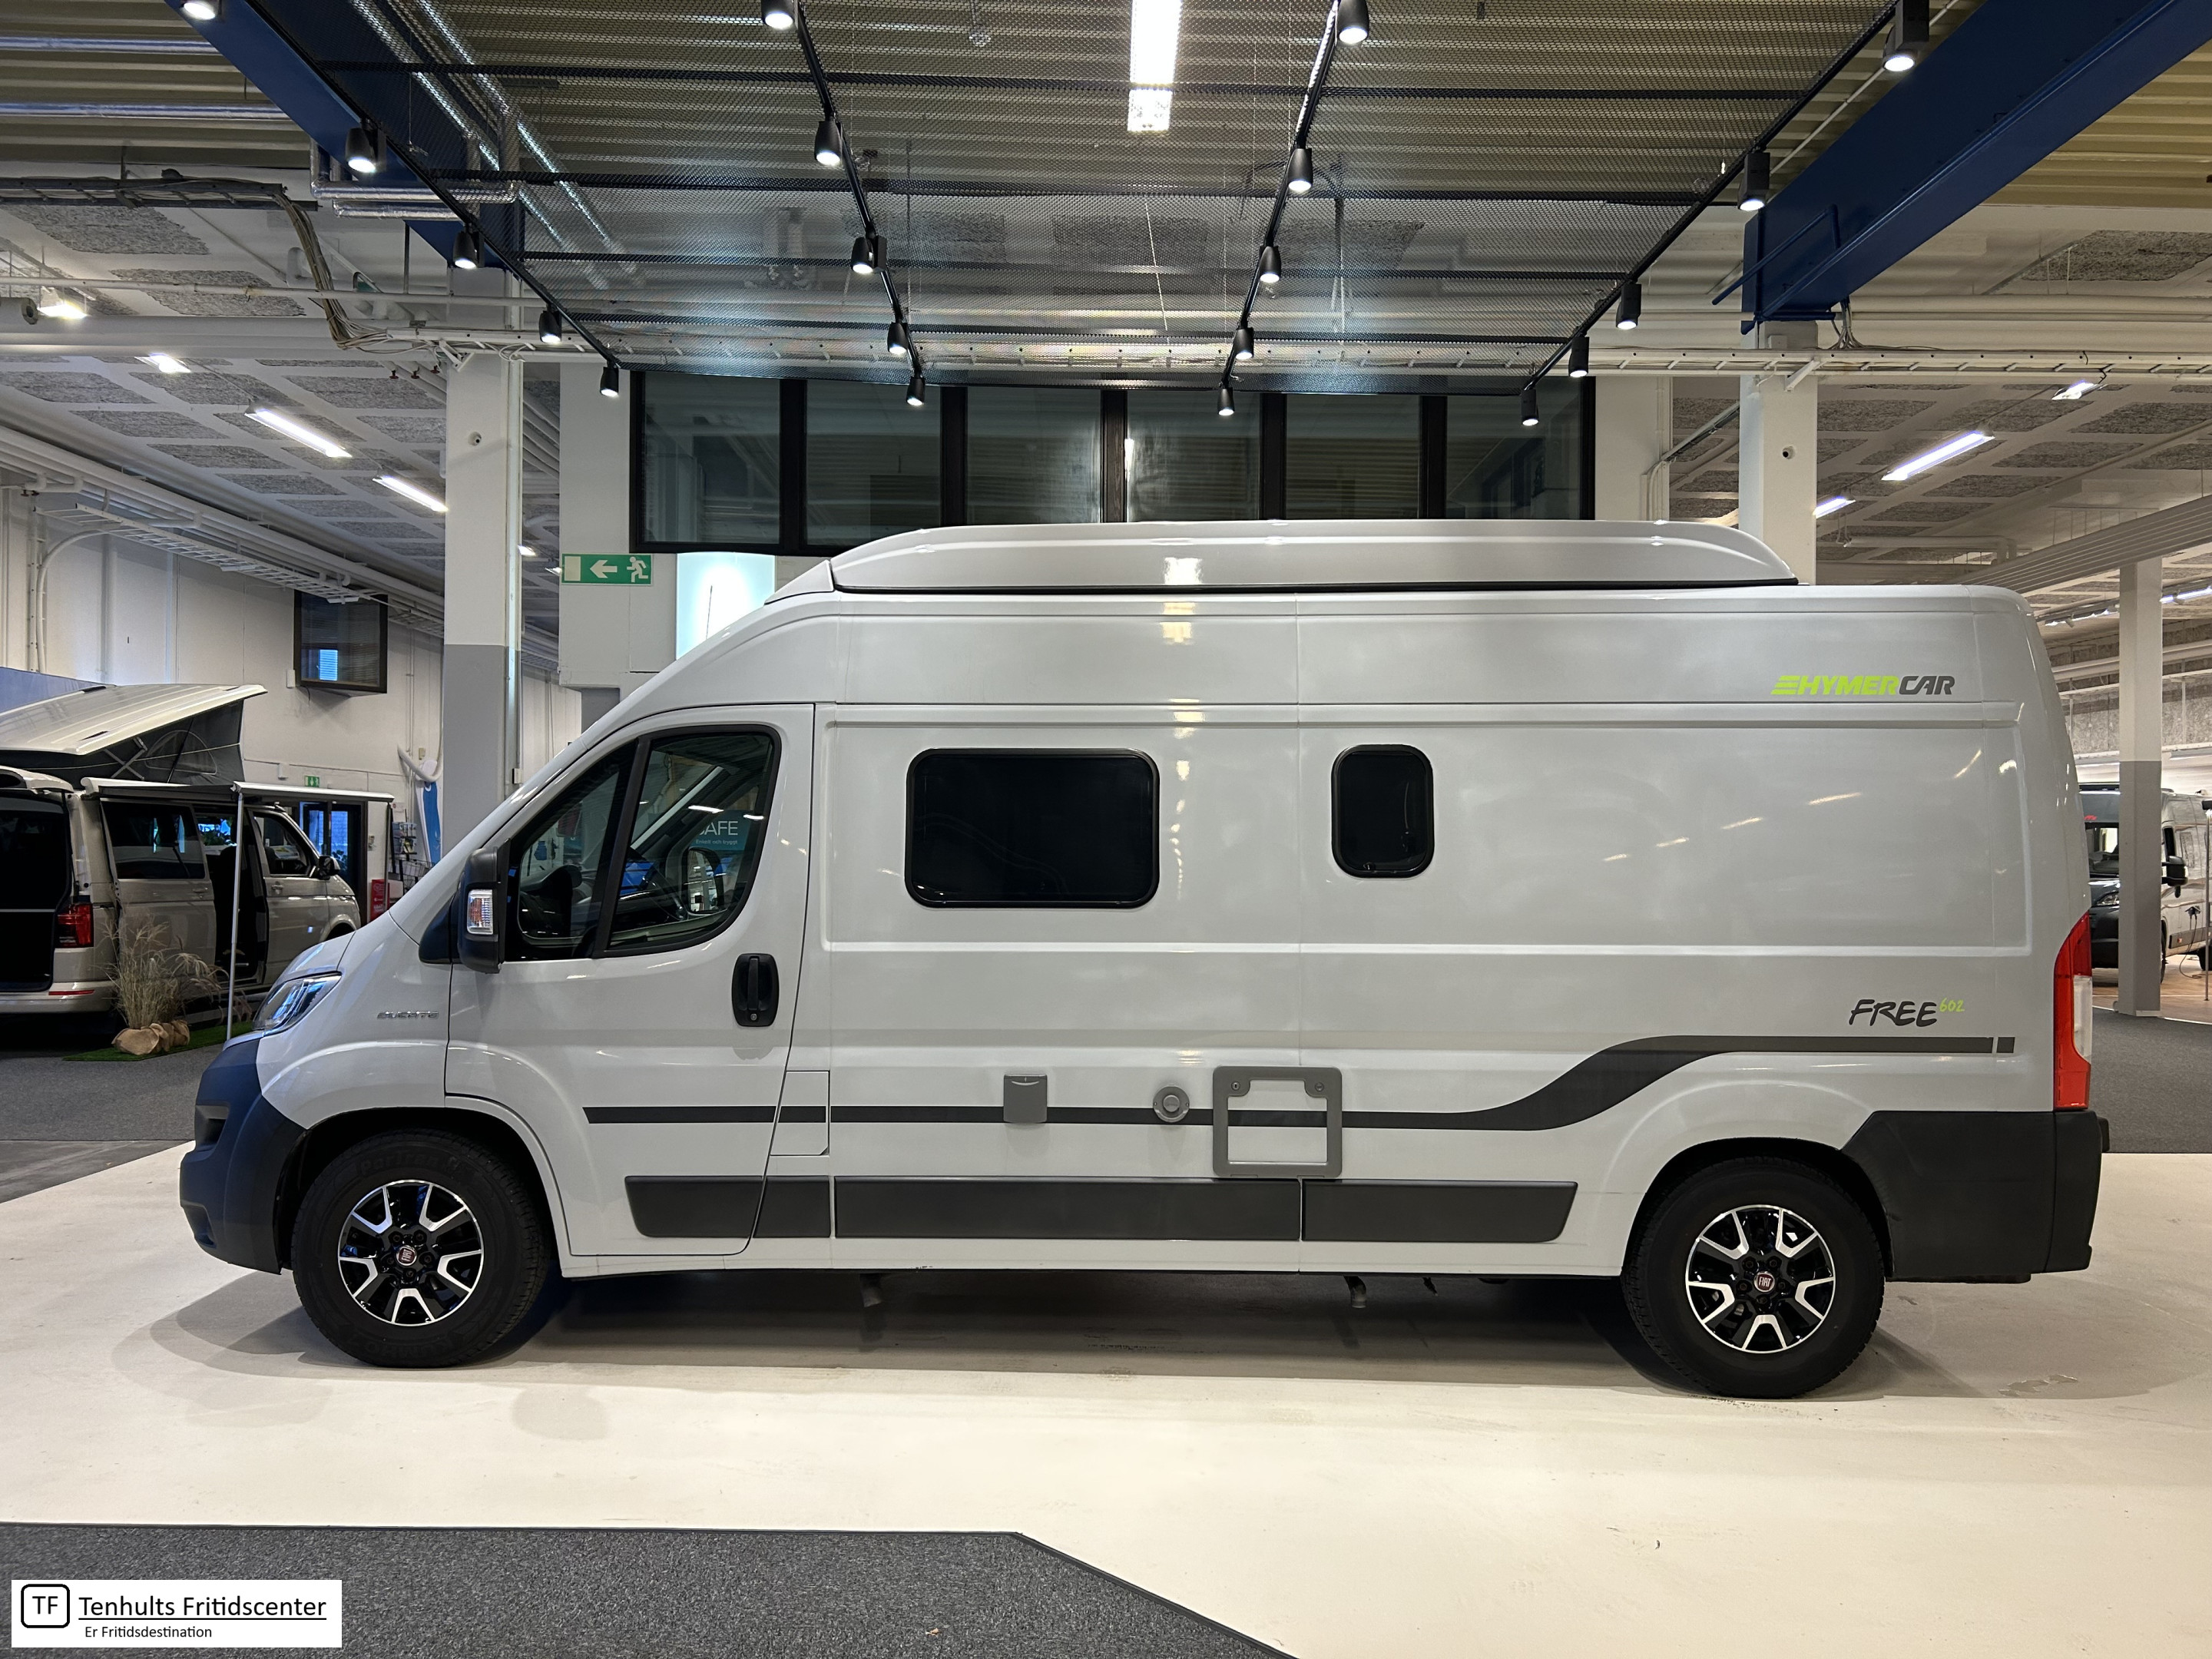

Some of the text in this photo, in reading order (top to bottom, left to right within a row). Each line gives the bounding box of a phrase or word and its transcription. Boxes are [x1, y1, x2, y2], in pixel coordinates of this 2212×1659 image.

[699, 820, 739, 836] AFE
[1848, 998, 1937, 1027] FREE
[401, 1248, 412, 1262] FIAT
[1759, 1276, 1772, 1287] FIAT
